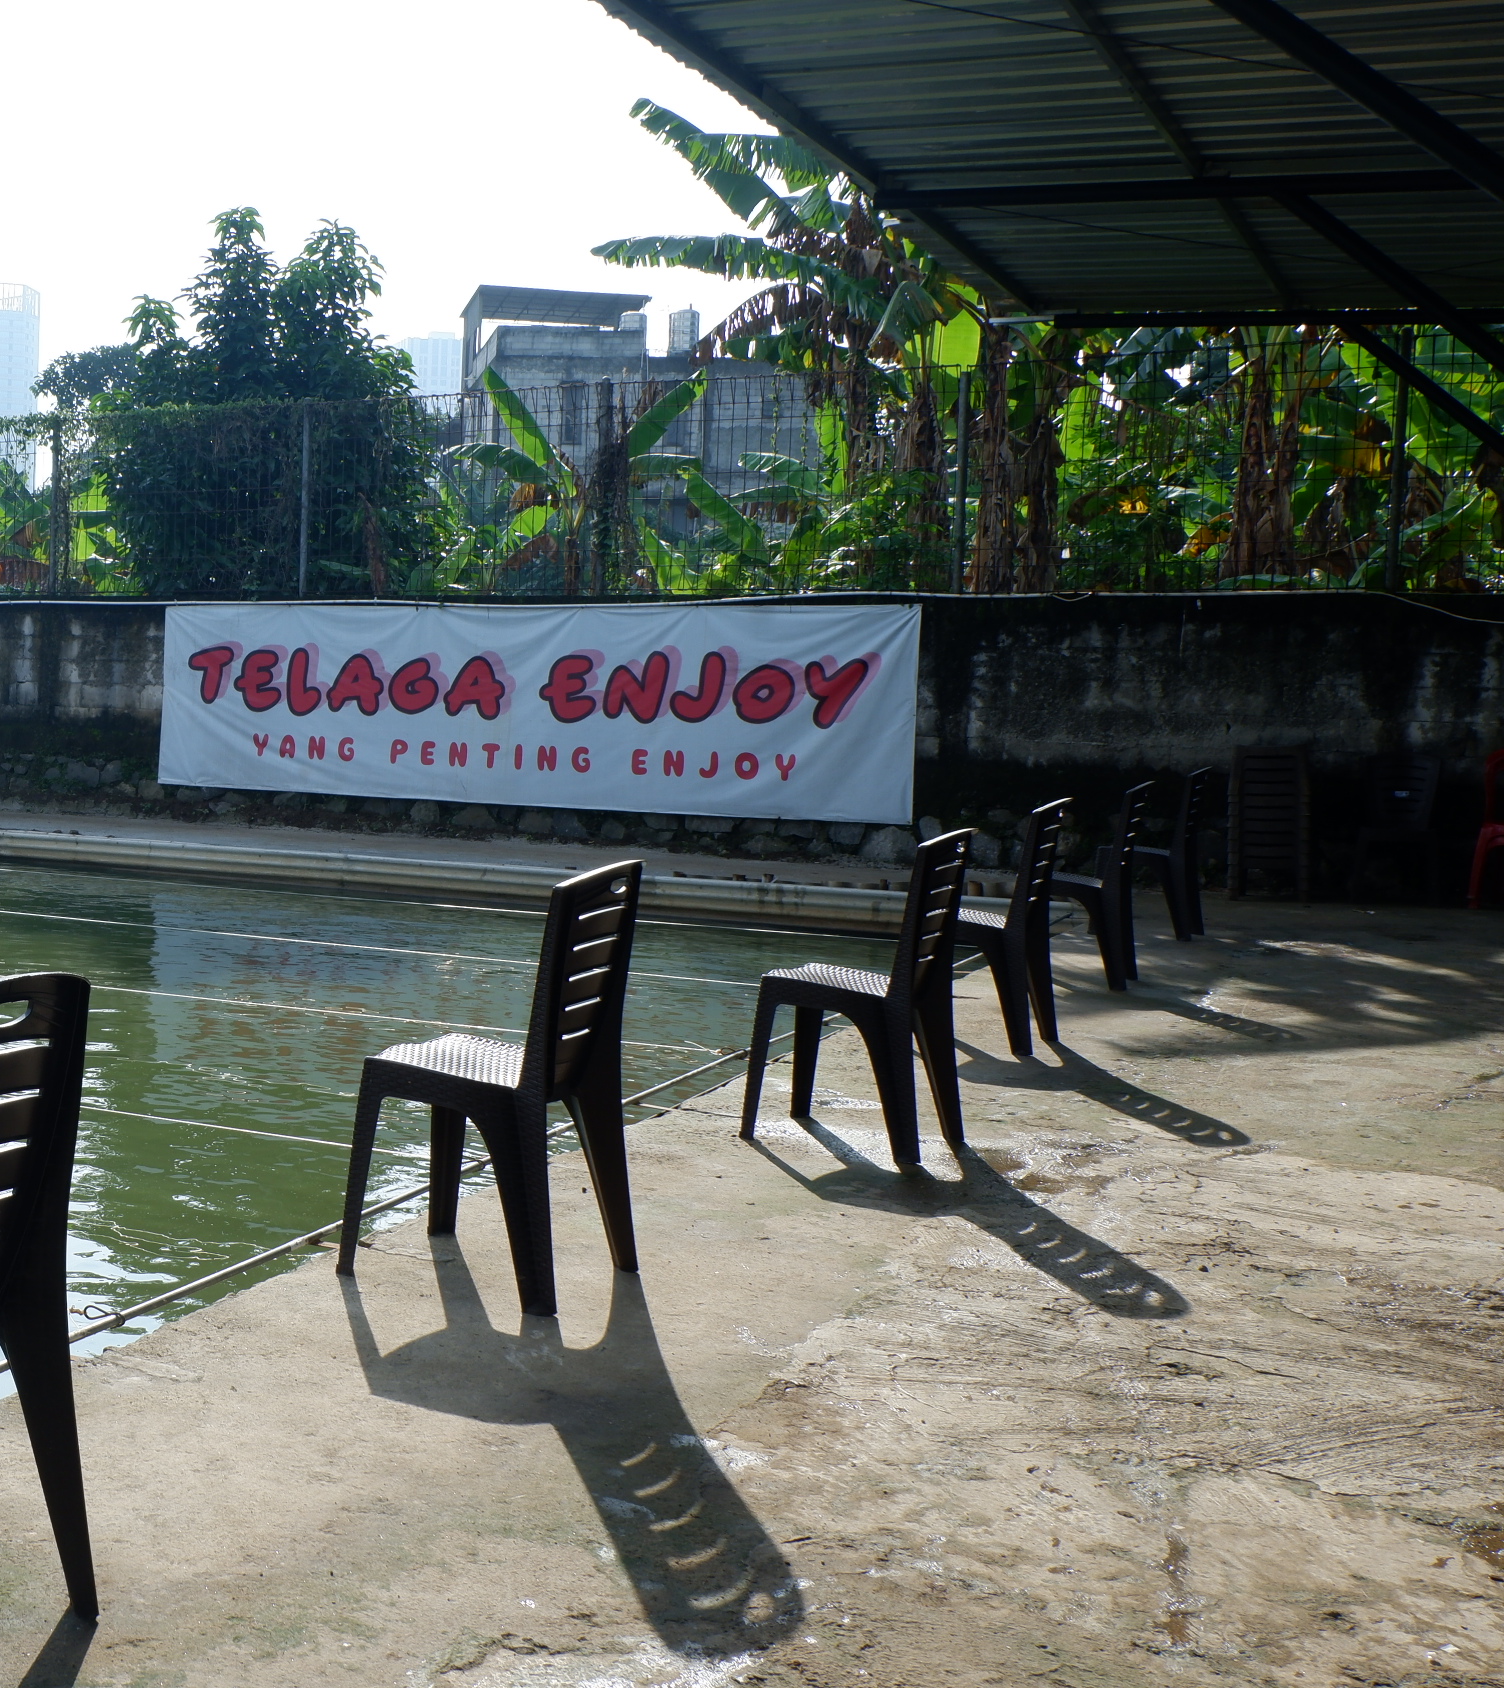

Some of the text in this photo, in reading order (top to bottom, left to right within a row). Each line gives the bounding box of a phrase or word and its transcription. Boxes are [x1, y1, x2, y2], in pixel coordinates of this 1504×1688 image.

[189, 642, 874, 729] TELAGA ENJOY
[253, 733, 796, 781] YANG PENTING ENJOY
